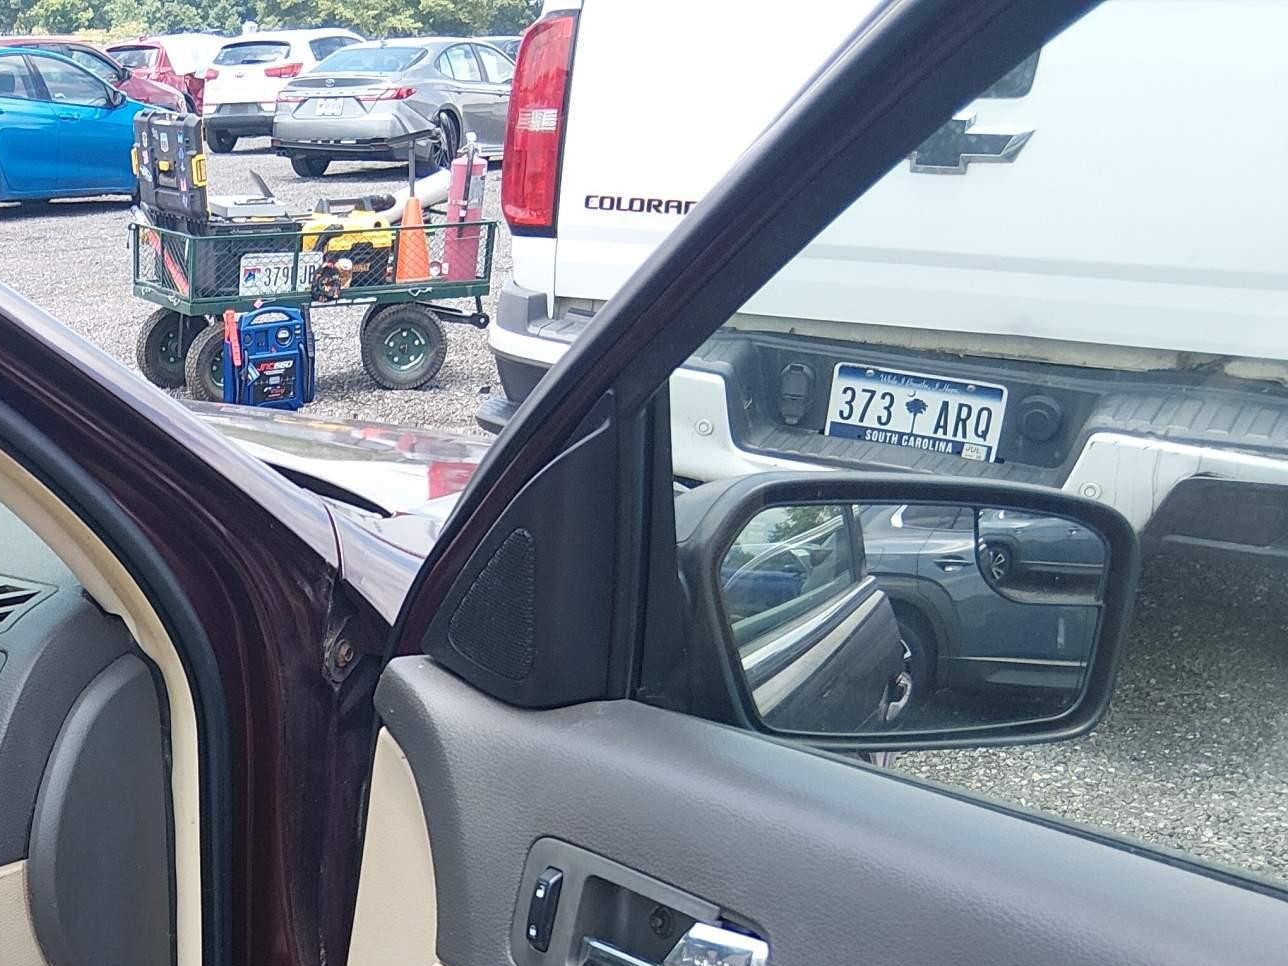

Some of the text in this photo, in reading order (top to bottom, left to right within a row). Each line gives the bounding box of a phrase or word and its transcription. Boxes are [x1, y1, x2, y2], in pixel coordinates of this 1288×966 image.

[838, 386, 993, 442] 373 ARQ
[865, 429, 953, 454] SOUTH CAROLINA
